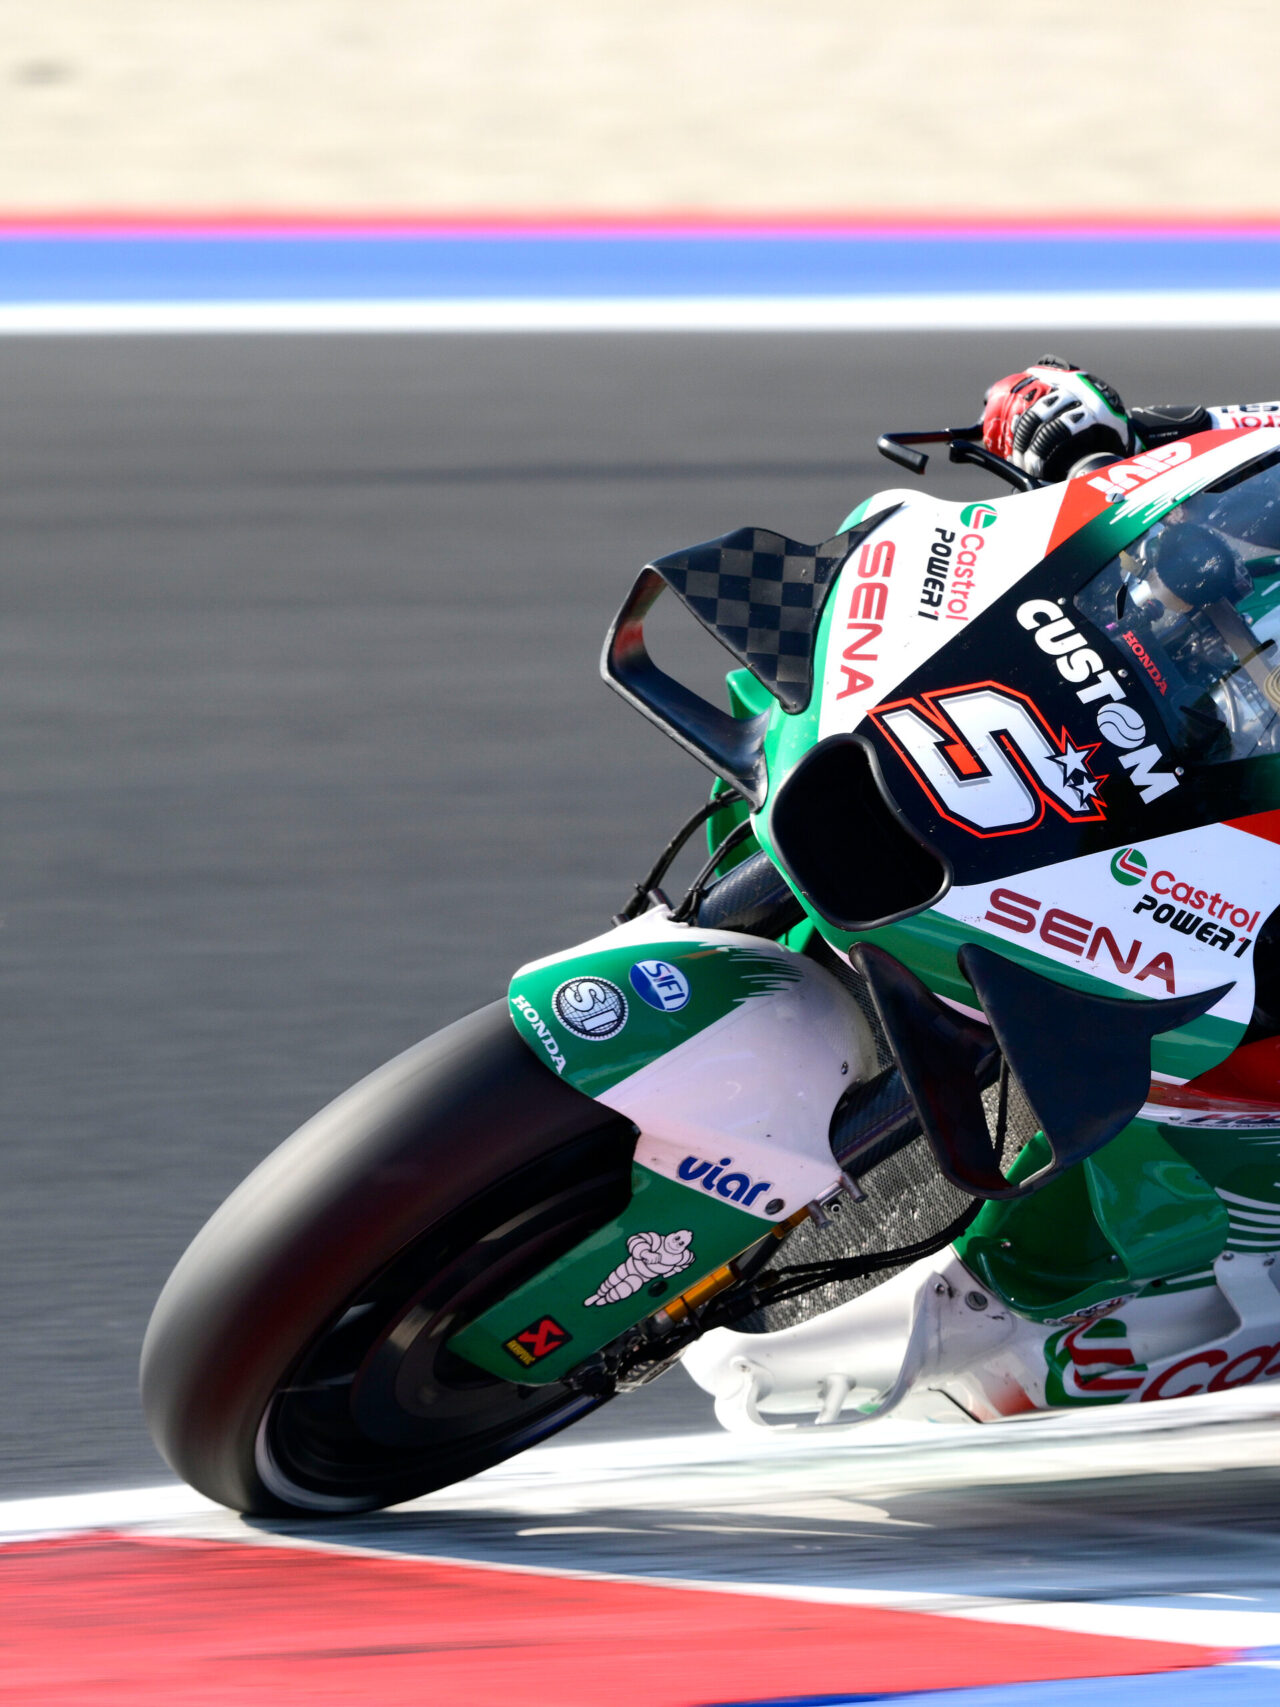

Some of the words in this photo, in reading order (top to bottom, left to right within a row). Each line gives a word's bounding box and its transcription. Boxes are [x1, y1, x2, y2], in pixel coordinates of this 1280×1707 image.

[1086, 441, 1192, 495] GIVI
[918, 527, 955, 621] POWER1
[945, 533, 985, 621] Castrol
[836, 540, 896, 701] SENA
[1122, 631, 1168, 697] HONDA
[1016, 598, 1180, 805] CUSTOM
[868, 681, 1100, 838] 5
[1133, 895, 1253, 960] POWER1
[1151, 870, 1261, 934] Castrol
[984, 888, 1176, 995] SENA
[563, 981, 619, 1033] SI
[641, 963, 686, 1002] SIFI
[511, 994, 567, 1075] HONDA
[678, 1156, 772, 1207] viar
